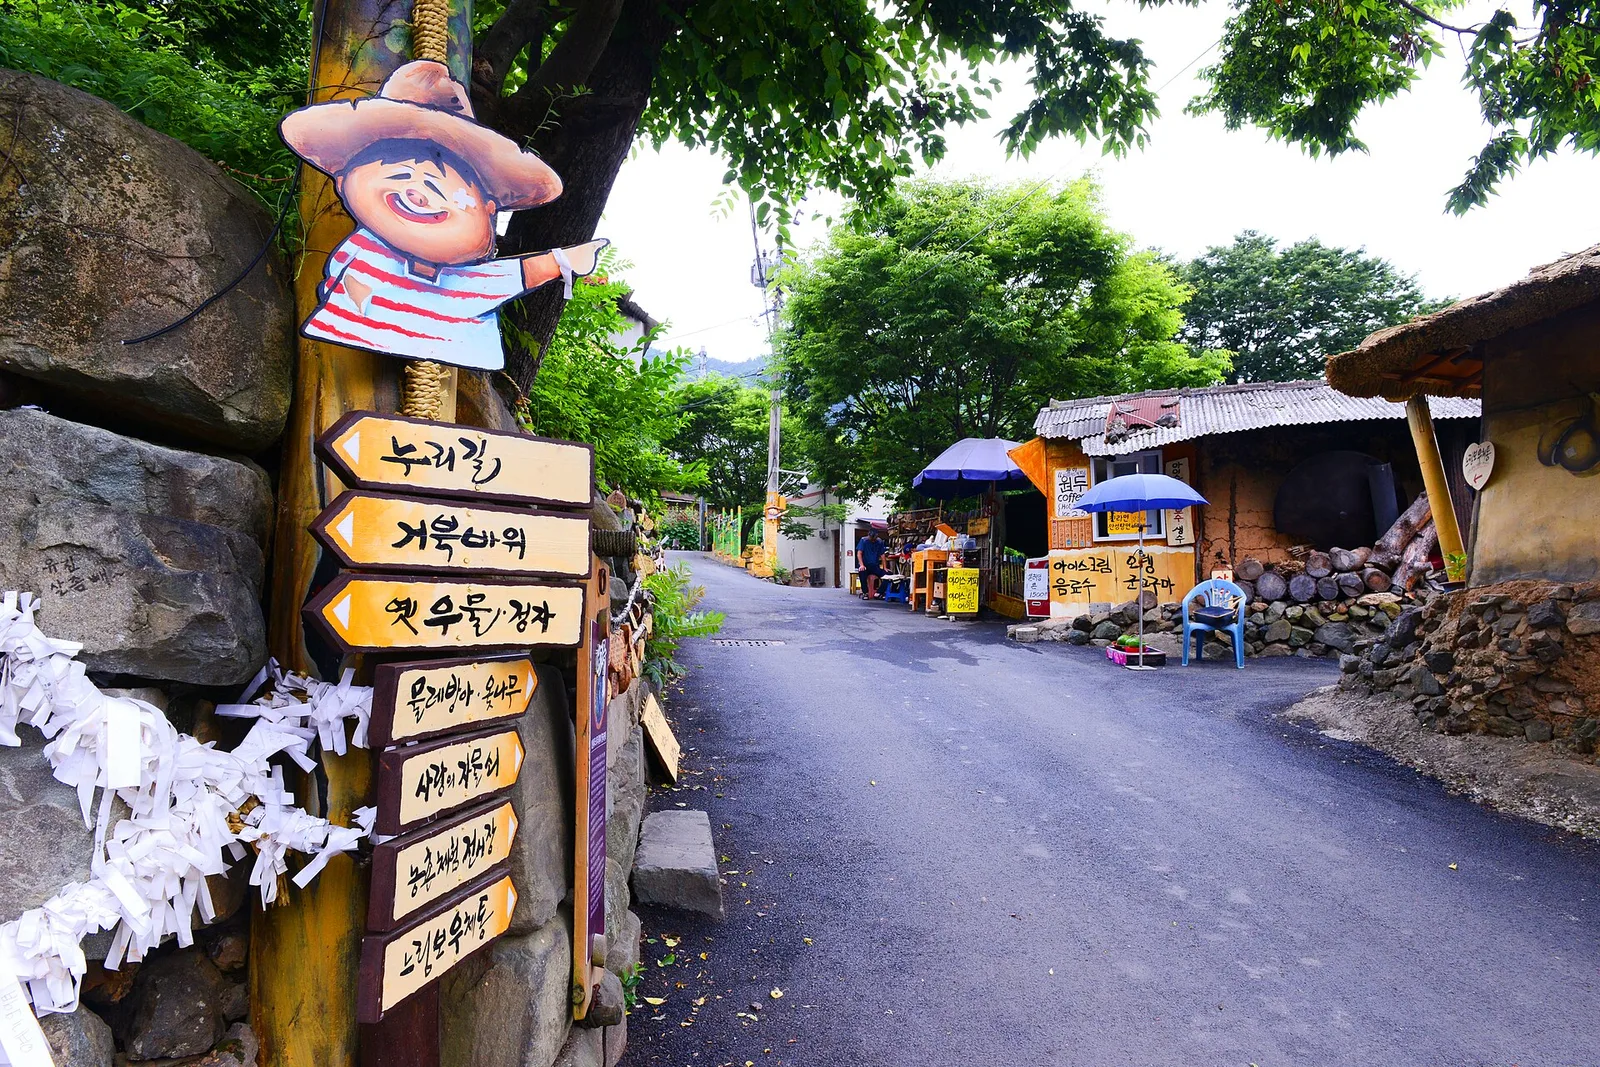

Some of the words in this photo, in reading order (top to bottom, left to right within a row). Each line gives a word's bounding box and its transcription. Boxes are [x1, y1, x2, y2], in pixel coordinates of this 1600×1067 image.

[380, 435, 502, 485] 누리길
[1059, 475, 1088, 493] 원두
[391, 514, 527, 562] 거북바위
[1053, 554, 1113, 574] 아이스크림
[1052, 577, 1097, 601] 음료수
[385, 596, 418, 636] 옛
[415, 761, 455, 802] 사랑의
